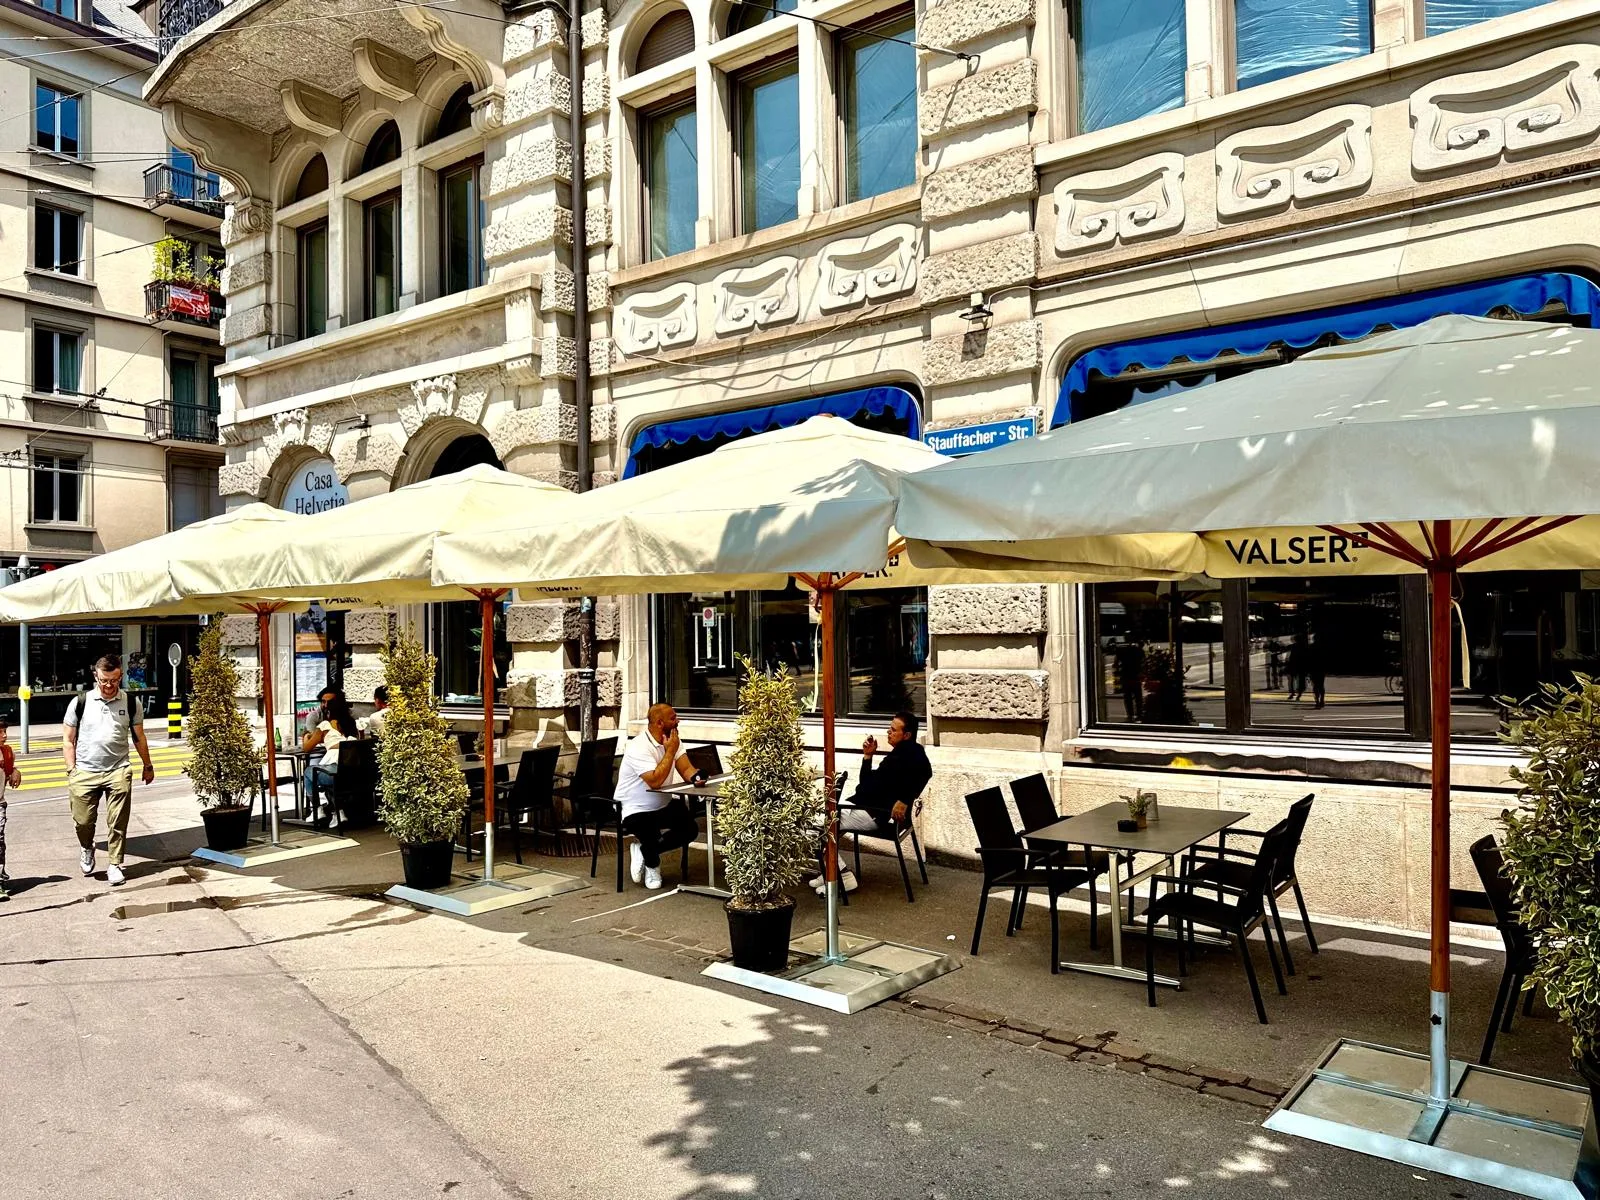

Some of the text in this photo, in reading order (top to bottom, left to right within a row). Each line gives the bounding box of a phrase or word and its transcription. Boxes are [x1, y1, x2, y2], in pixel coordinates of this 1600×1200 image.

[928, 430, 998, 451] Stauffacher
[1008, 425, 1029, 441] Str.
[305, 471, 333, 492] Casa
[1224, 535, 1352, 565] VALSER
